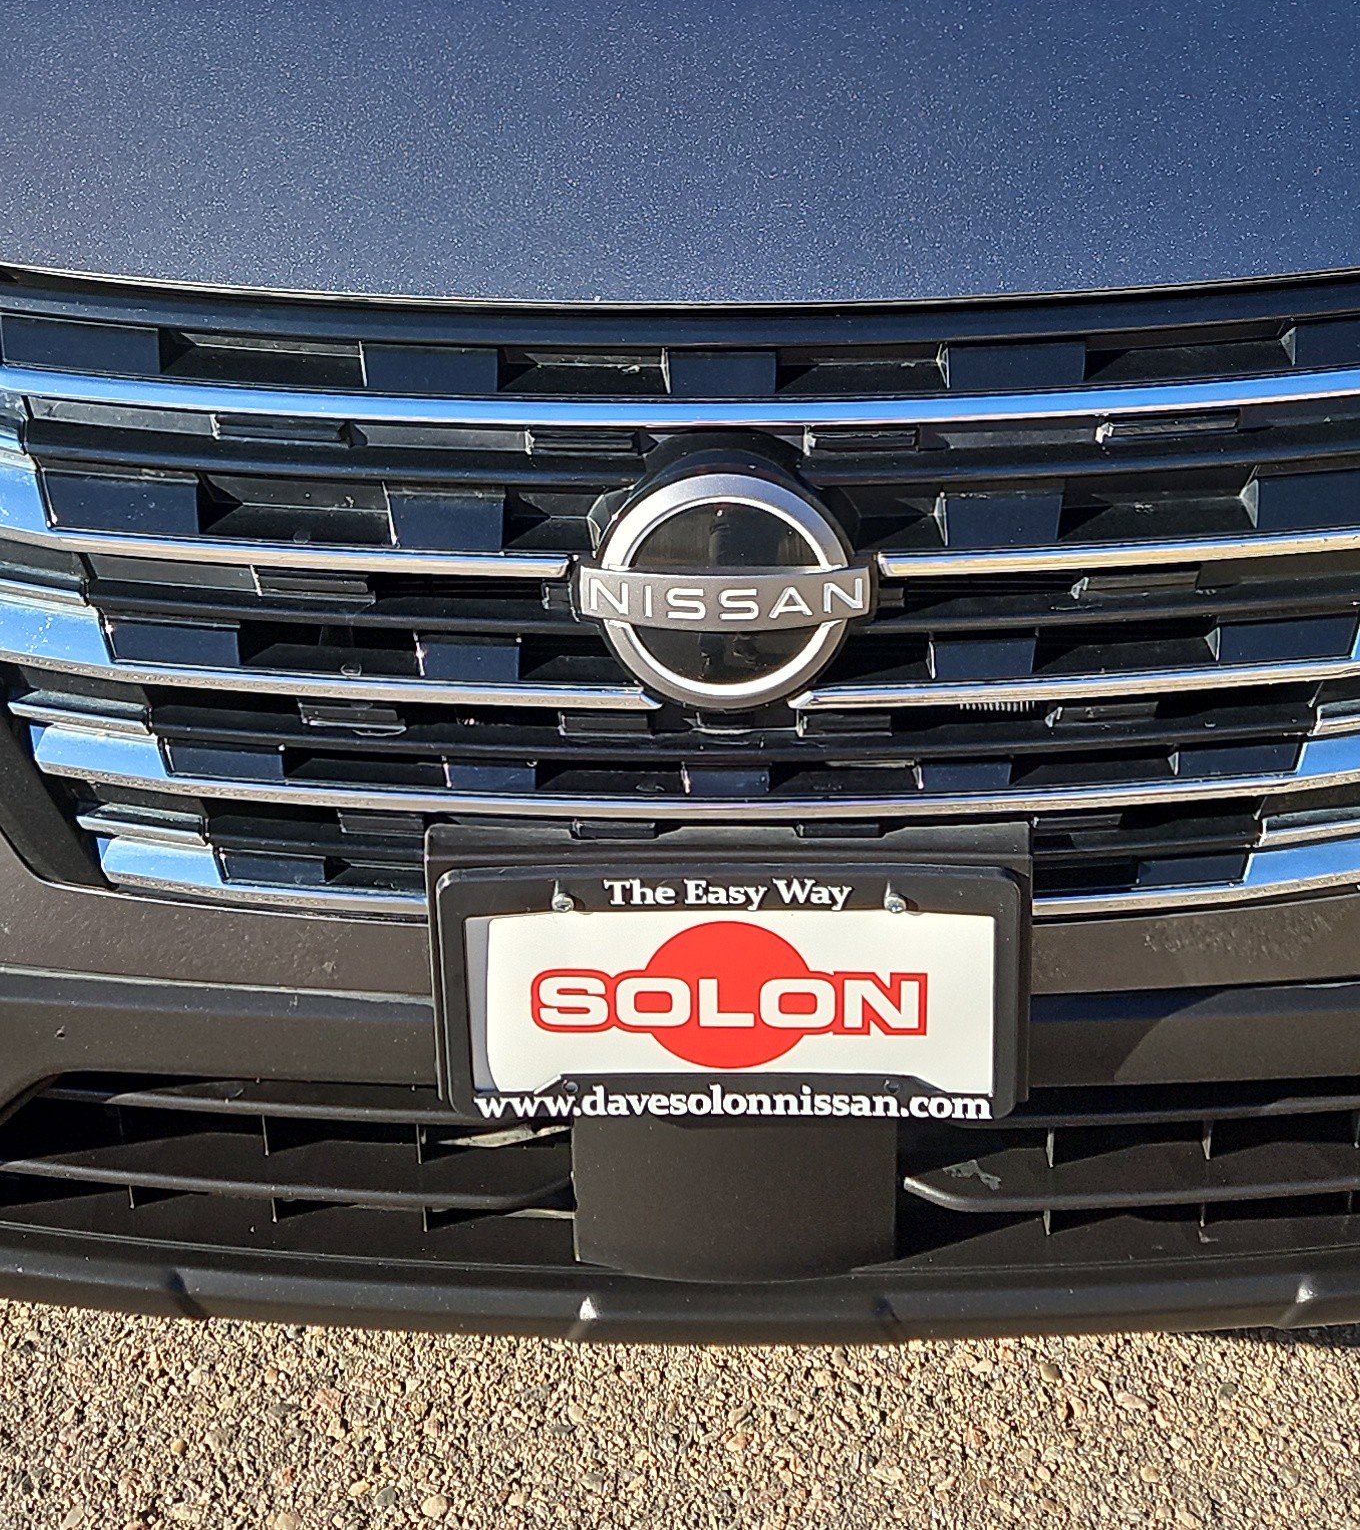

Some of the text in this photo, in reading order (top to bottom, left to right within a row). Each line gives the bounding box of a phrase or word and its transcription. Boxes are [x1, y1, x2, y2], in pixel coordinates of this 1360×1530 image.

[589, 577, 864, 621] NISSAN
[603, 879, 853, 911] The Easy Way
[533, 970, 926, 1034] SOLON
[473, 1084, 994, 1120] www.davesolonnissan.com
